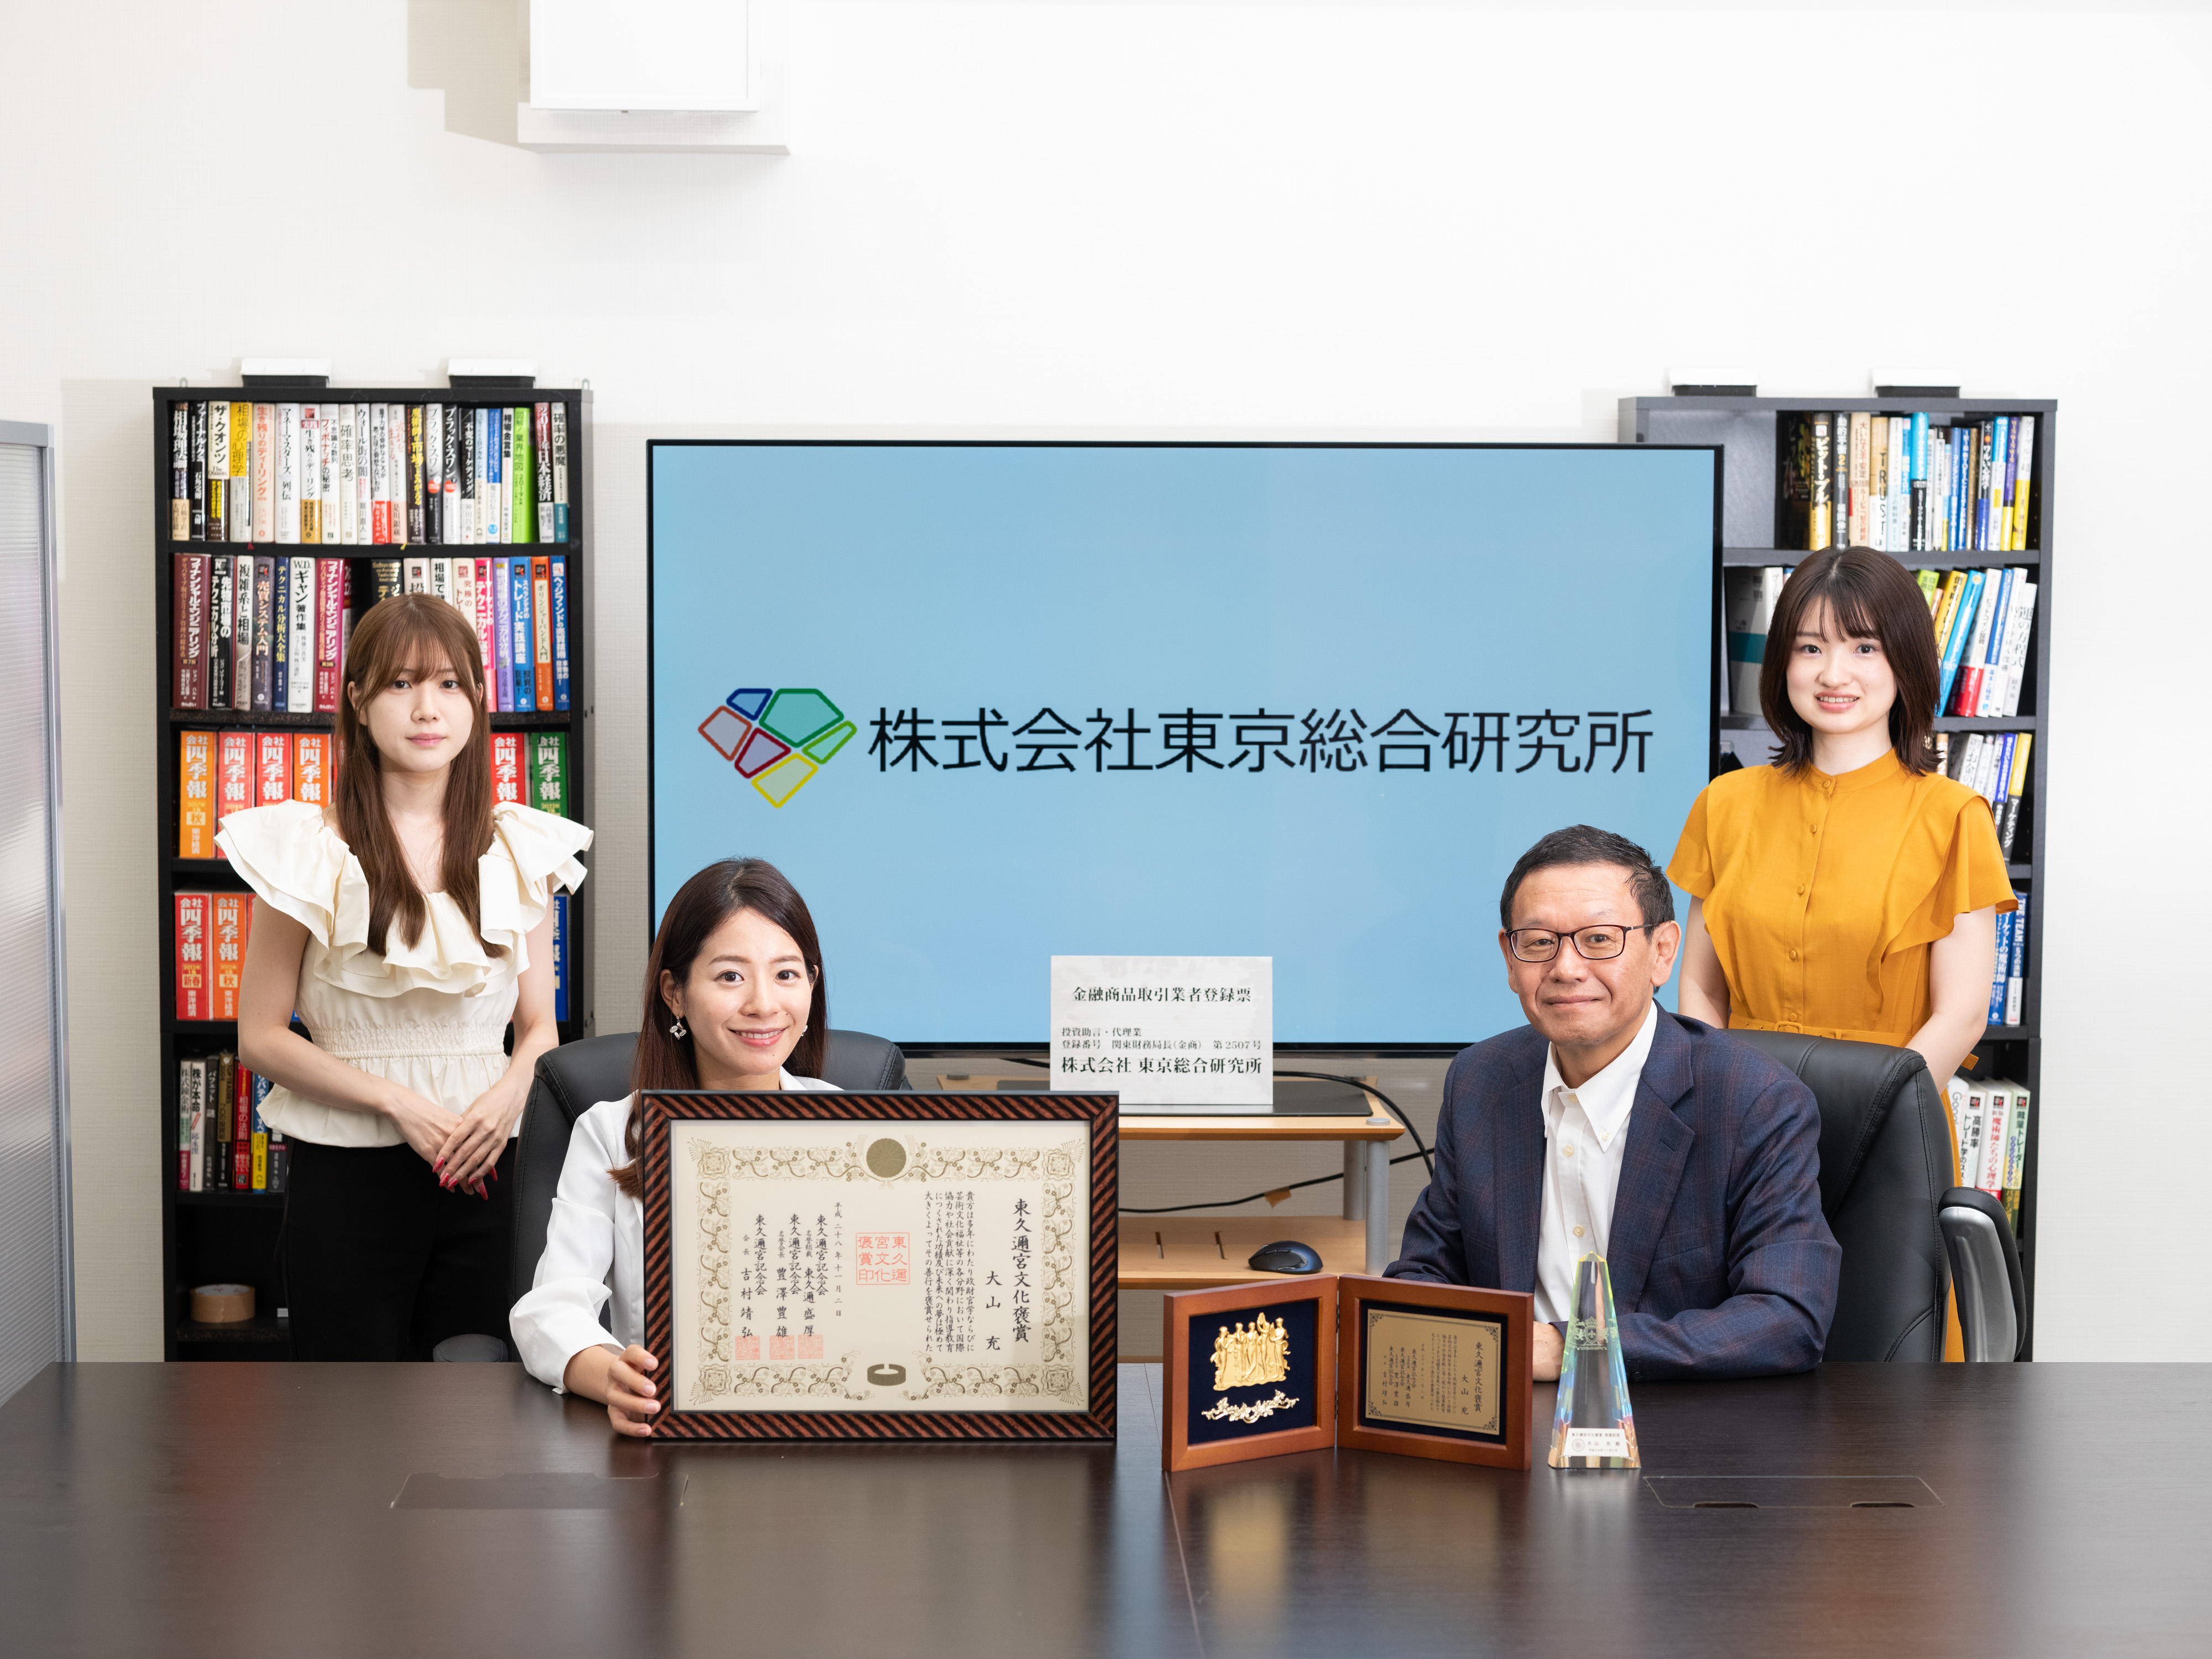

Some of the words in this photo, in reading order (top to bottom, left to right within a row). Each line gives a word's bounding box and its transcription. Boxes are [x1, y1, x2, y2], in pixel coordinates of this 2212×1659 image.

[215, 405, 227, 463] ザ・クオンツ
[232, 404, 249, 476] 相場の心理学
[257, 407, 267, 497] 生き残りのディーリング
[321, 419, 330, 492] フィボナッチの秘密
[341, 425, 354, 482] 確率思考
[358, 409, 368, 477] ウォール街の闇
[428, 408, 439, 477] ブラック・スワン
[445, 407, 457, 479] ブラック・スワン
[554, 413, 566, 466] 確率の悪魔
[211, 576, 220, 658] テクニカル分析
[221, 576, 232, 638] 先物市場の
[238, 564, 250, 645] 複雑系と相場
[276, 566, 286, 662] テクニカル分析大全集
[294, 570, 309, 630] ギャン著作集
[514, 580, 526, 664] トレード実践講座
[868, 707, 1653, 773] 株式会社東京総合研究所
[186, 745, 208, 799] 四季報
[224, 748, 246, 801] 四季報
[262, 747, 284, 800] 四季報
[299, 748, 321, 801] 四季報
[494, 747, 518, 801] 四季報
[538, 747, 561, 800] 四季報
[2004, 799, 2020, 848] マーケティング
[180, 909, 202, 962] 四季報
[218, 909, 238, 961] 四季報
[2015, 918, 2025, 942] TEAM
[2016, 898, 2026, 916] THE
[1072, 987, 1251, 1003] 金融商品取引業者登録票
[1062, 1027, 1142, 1036] 投資助言・代理業
[1062, 1040, 1101, 1050] 登録番号
[1061, 1057, 1131, 1073] 株式会社
[1138, 1057, 1262, 1074] 東京総合研究所
[1970, 1115, 1982, 1149] 高勝率
[1986, 1118, 2001, 1188] 魔術師たちの心理学
[754, 1214, 768, 1296] 東久邇宮記念会
[788, 1213, 802, 1295] 東久邇宮記念会
[815, 1214, 828, 1296] 東久邇宮記念会
[1011, 1198, 1032, 1343] 東久邇宮文化褒賞
